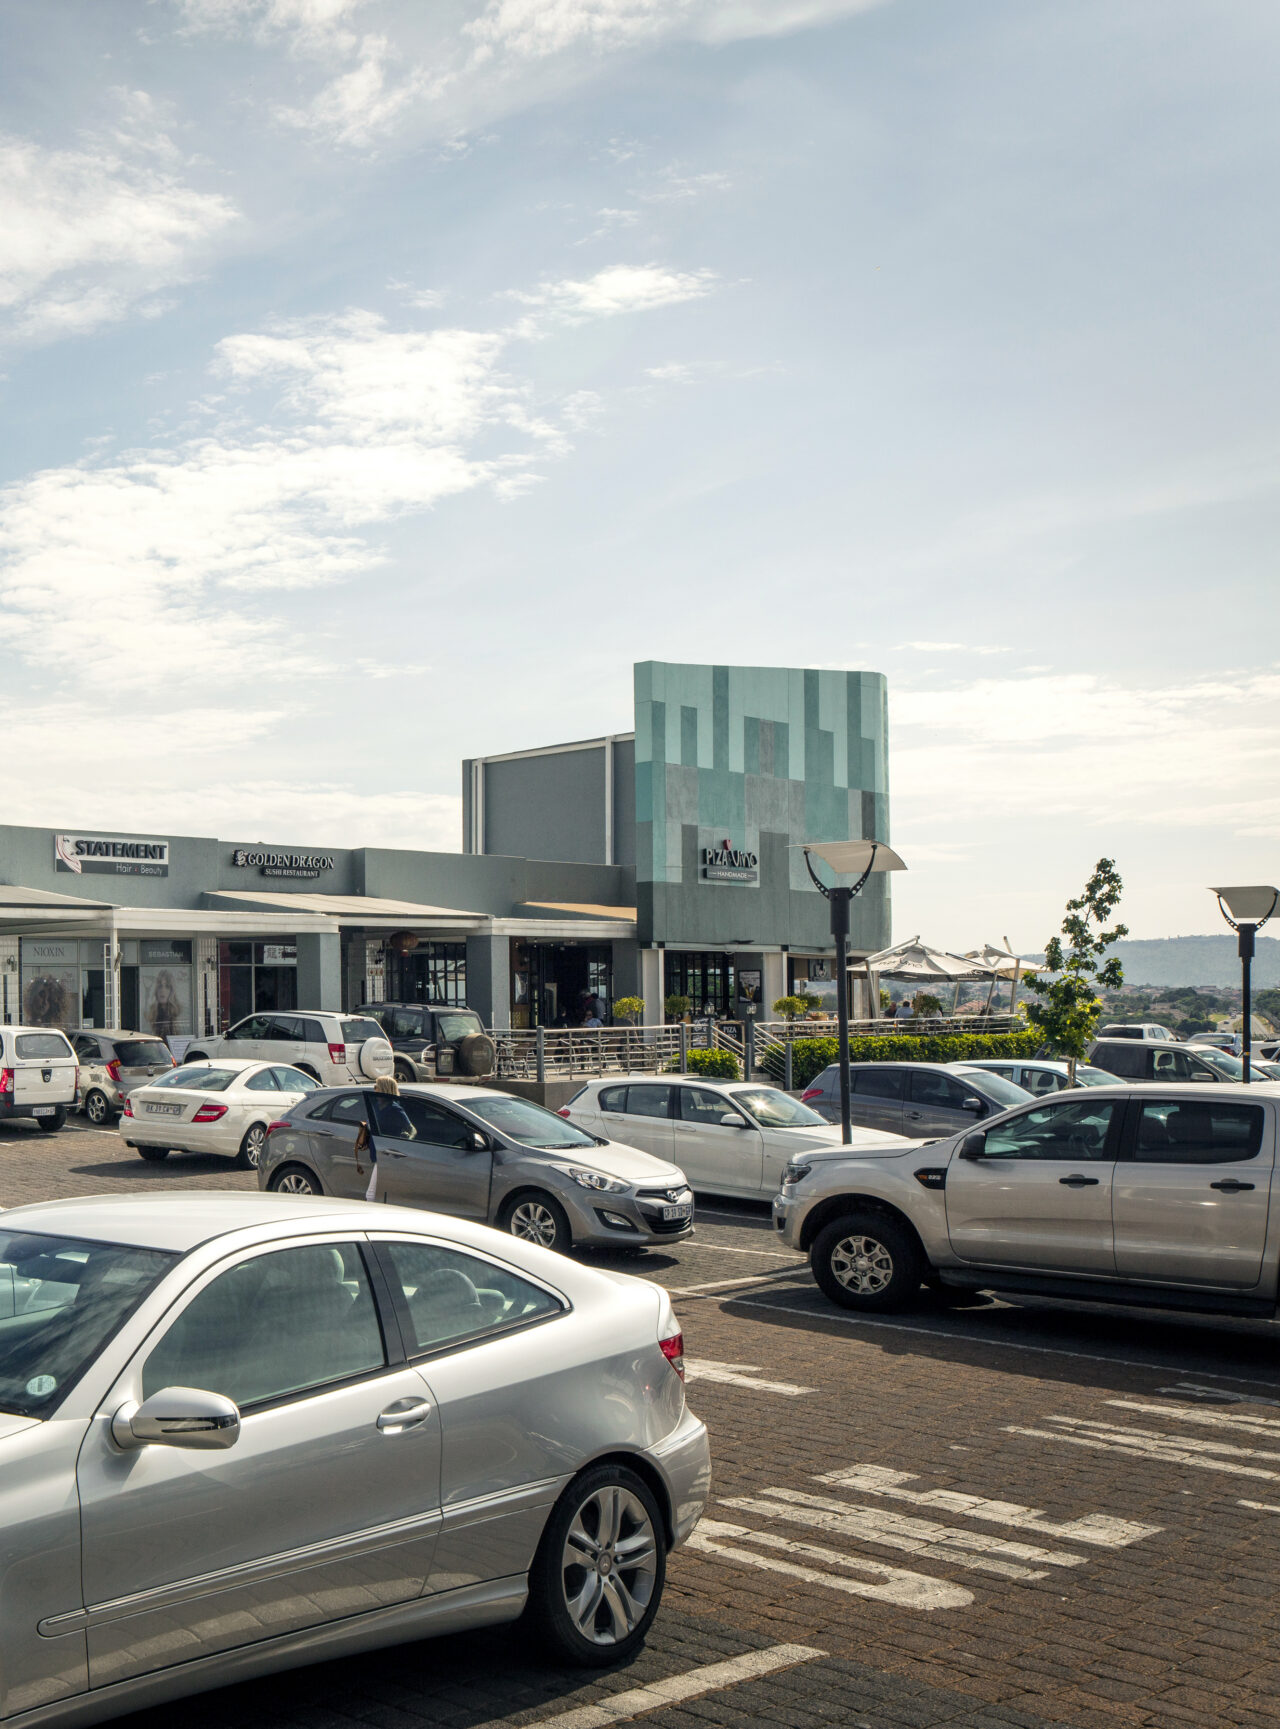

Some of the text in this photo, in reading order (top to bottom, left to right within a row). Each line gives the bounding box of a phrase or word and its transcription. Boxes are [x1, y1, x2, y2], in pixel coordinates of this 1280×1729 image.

[75, 839, 167, 859] STATEMENT
[248, 853, 335, 869] GOLDEN DRAGON
[116, 863, 132, 873] Hair
[140, 865, 162, 876] Beauty
[282, 869, 319, 877] RESTAURANT
[717, 871, 748, 879] HANDMADE
[33, 947, 65, 958] NIOXIN
[148, 950, 184, 958] SEBASTIAN
